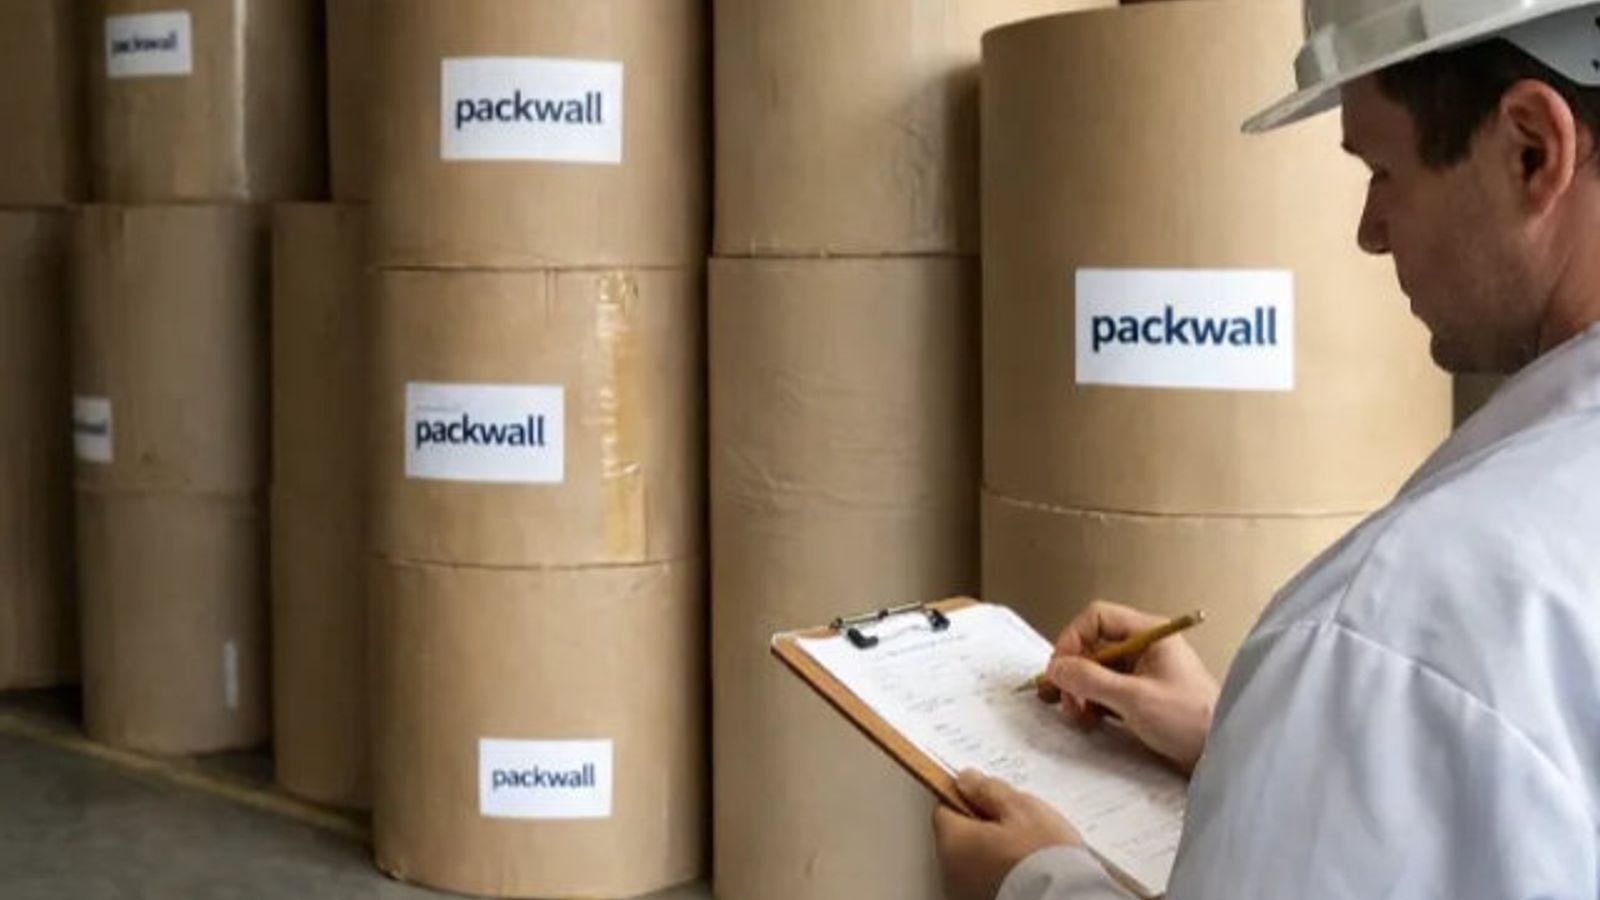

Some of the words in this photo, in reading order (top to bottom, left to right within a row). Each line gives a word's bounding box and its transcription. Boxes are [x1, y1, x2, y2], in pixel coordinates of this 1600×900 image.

[454, 90, 602, 131] packwall
[1091, 305, 1276, 354] packwall
[415, 412, 544, 450] packwall
[492, 762, 595, 791] packwall
